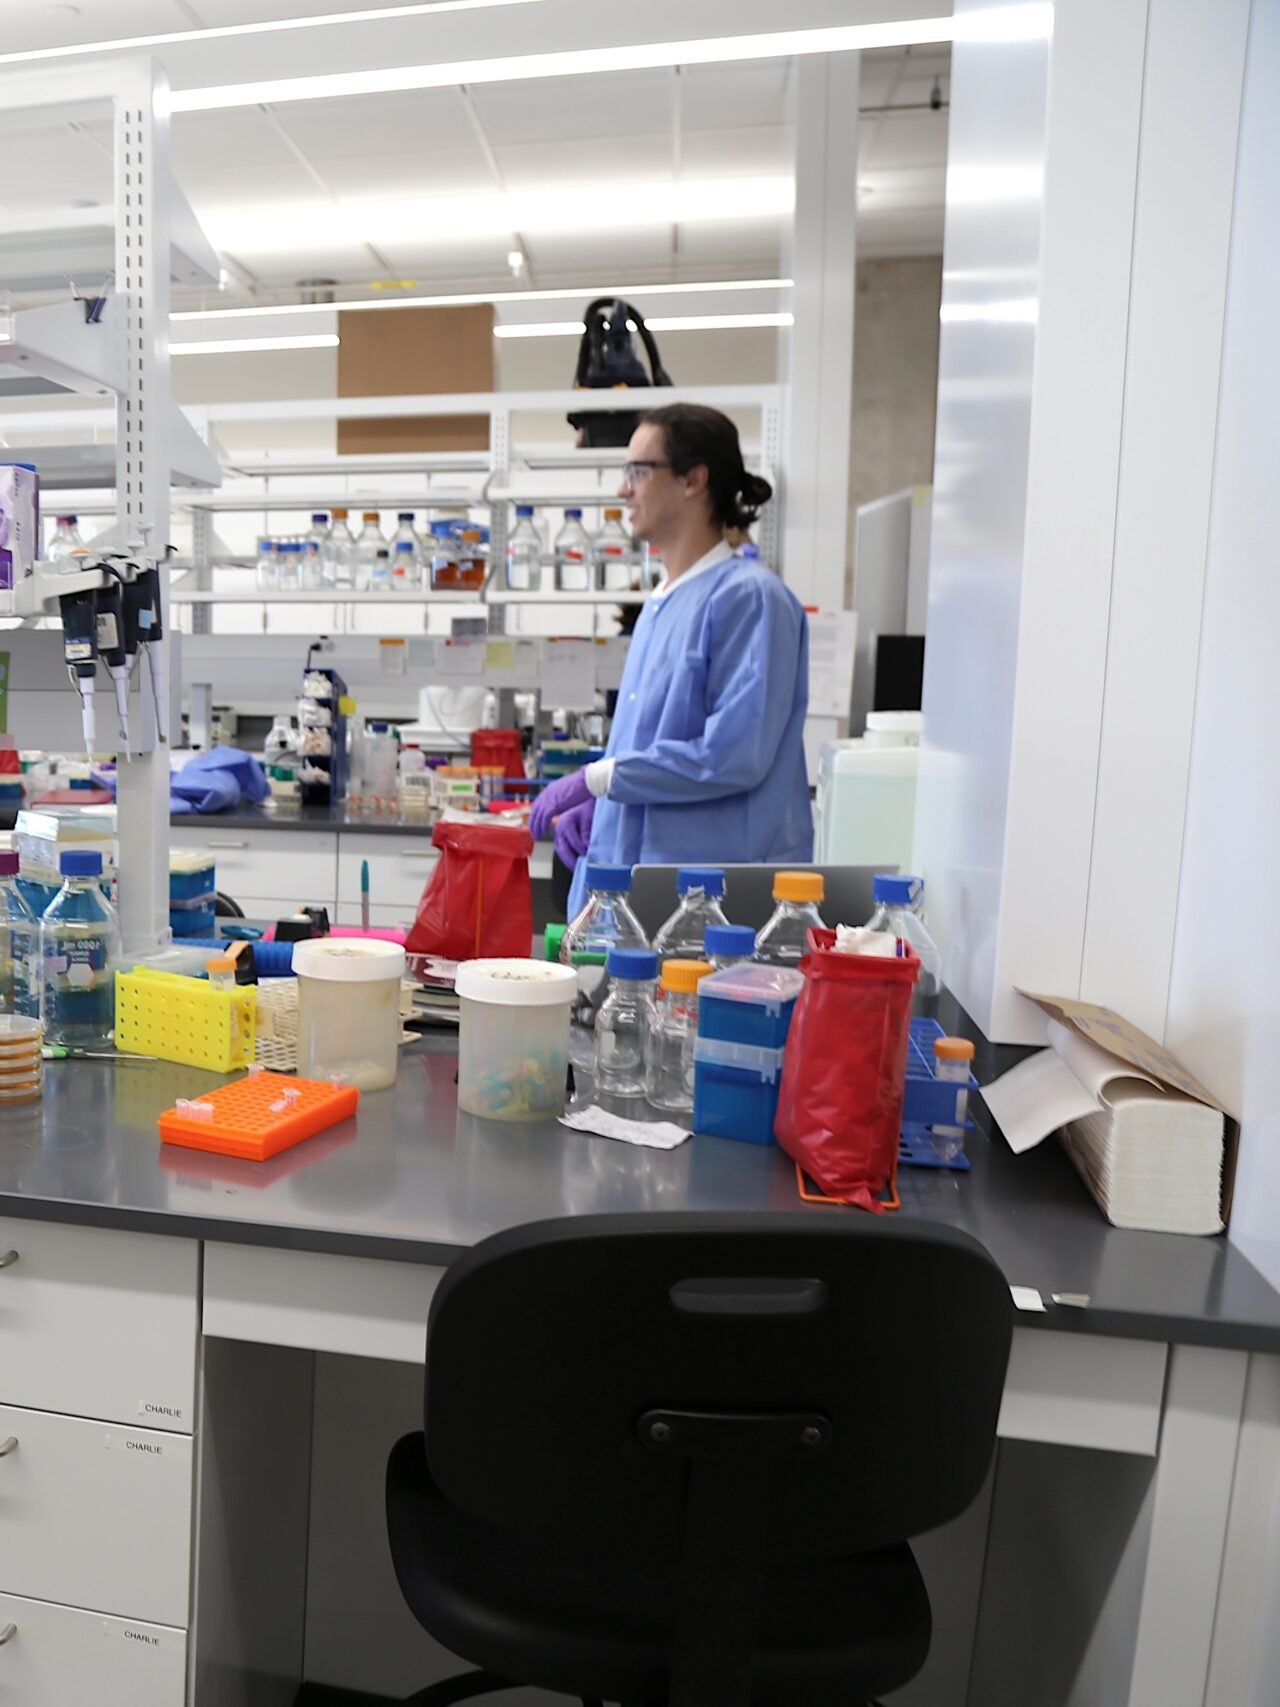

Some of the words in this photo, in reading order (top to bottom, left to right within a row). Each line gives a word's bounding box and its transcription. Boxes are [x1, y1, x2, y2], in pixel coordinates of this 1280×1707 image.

[145, 1404, 181, 1417] CHARLIE
[126, 1441, 163, 1454] CHARLIE
[124, 1631, 159, 1646] CHARLIE
